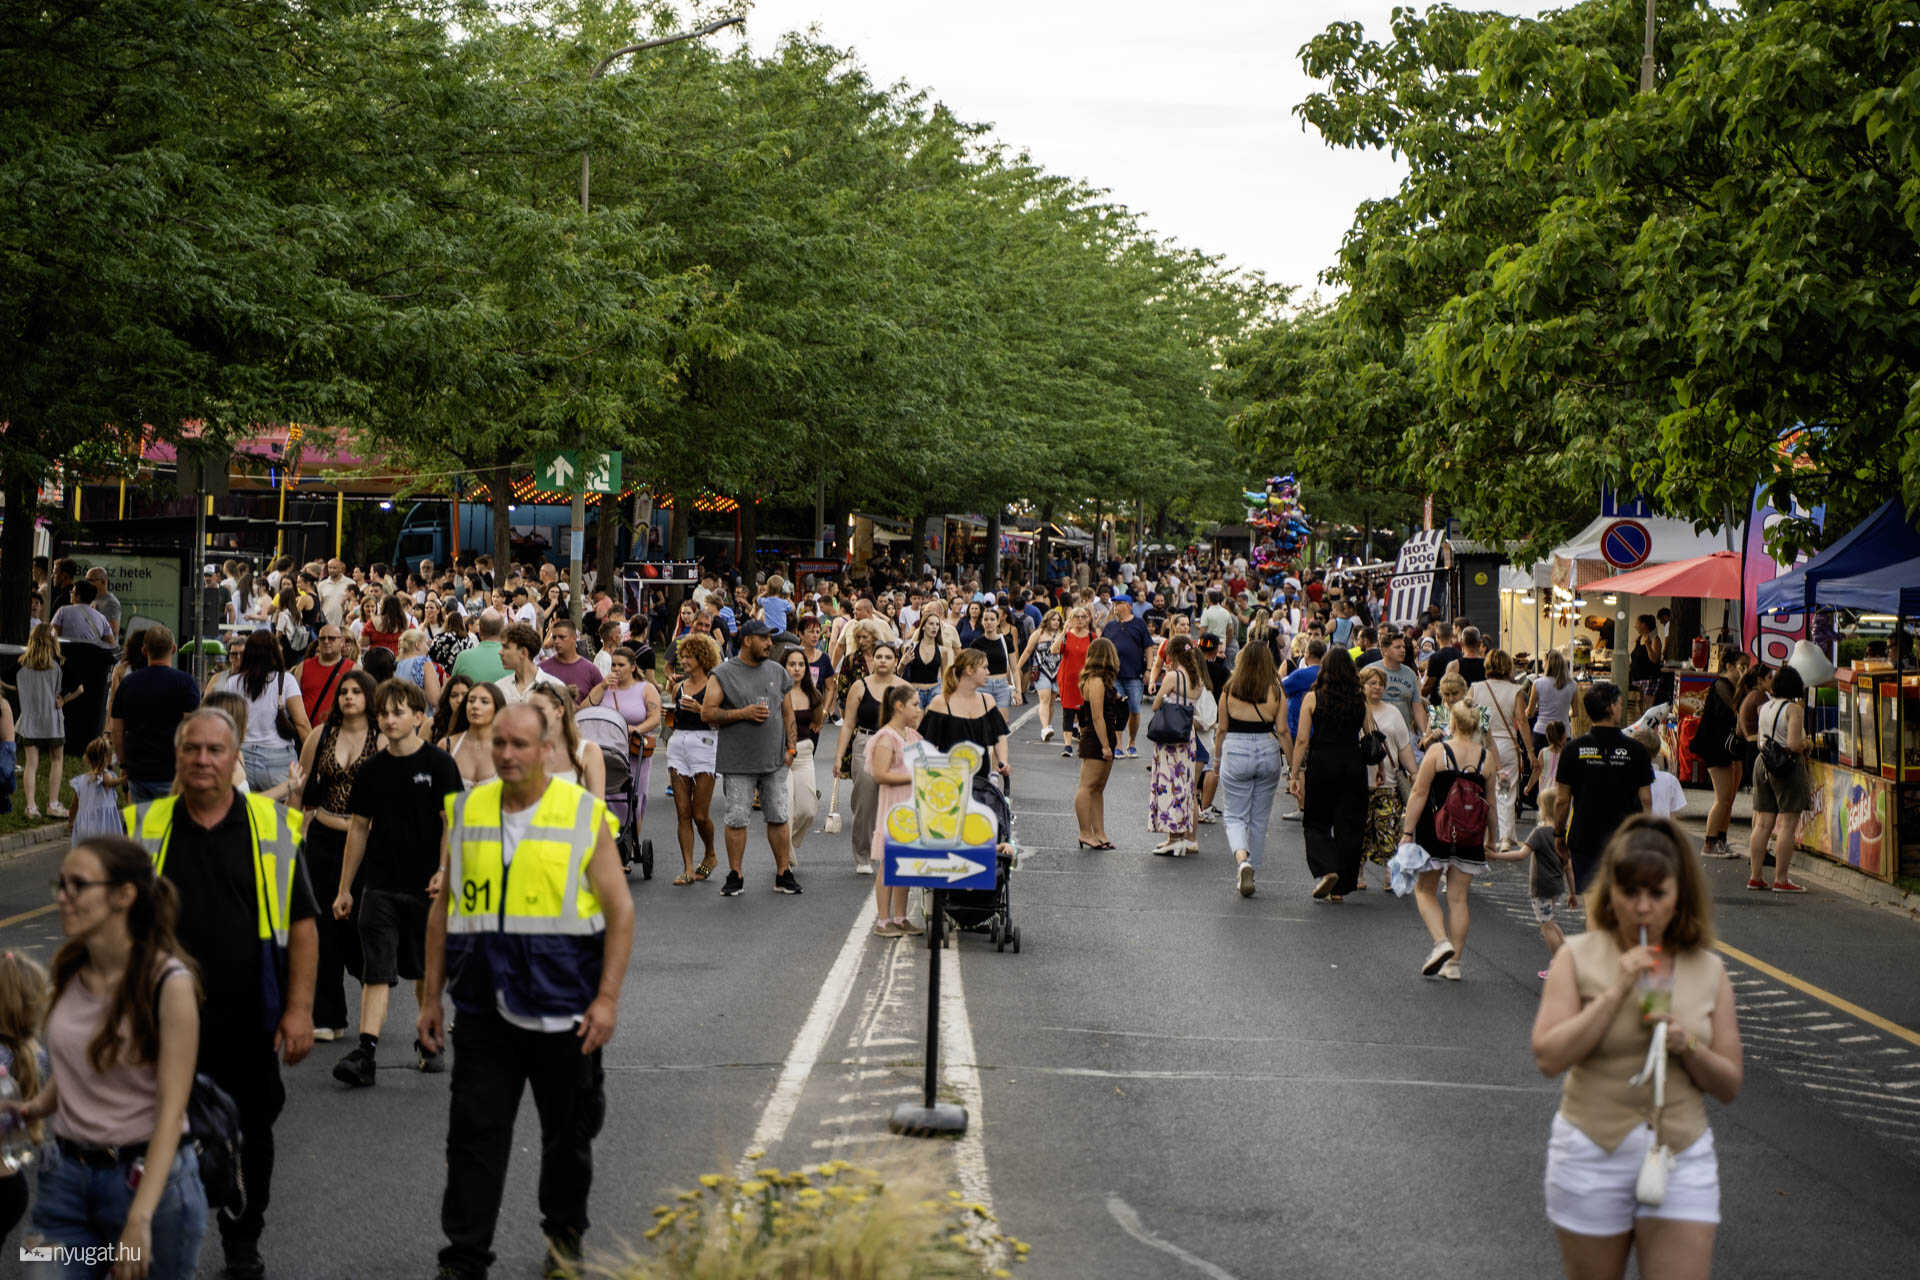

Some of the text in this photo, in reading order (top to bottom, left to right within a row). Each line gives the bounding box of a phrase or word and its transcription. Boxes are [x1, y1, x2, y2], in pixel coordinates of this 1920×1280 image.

[1403, 544, 1433, 556] HOT-
[1409, 553, 1435, 565] DOG
[120, 566, 152, 579] hetek
[1392, 574, 1431, 588] GOFRI
[463, 879, 490, 912] 91
